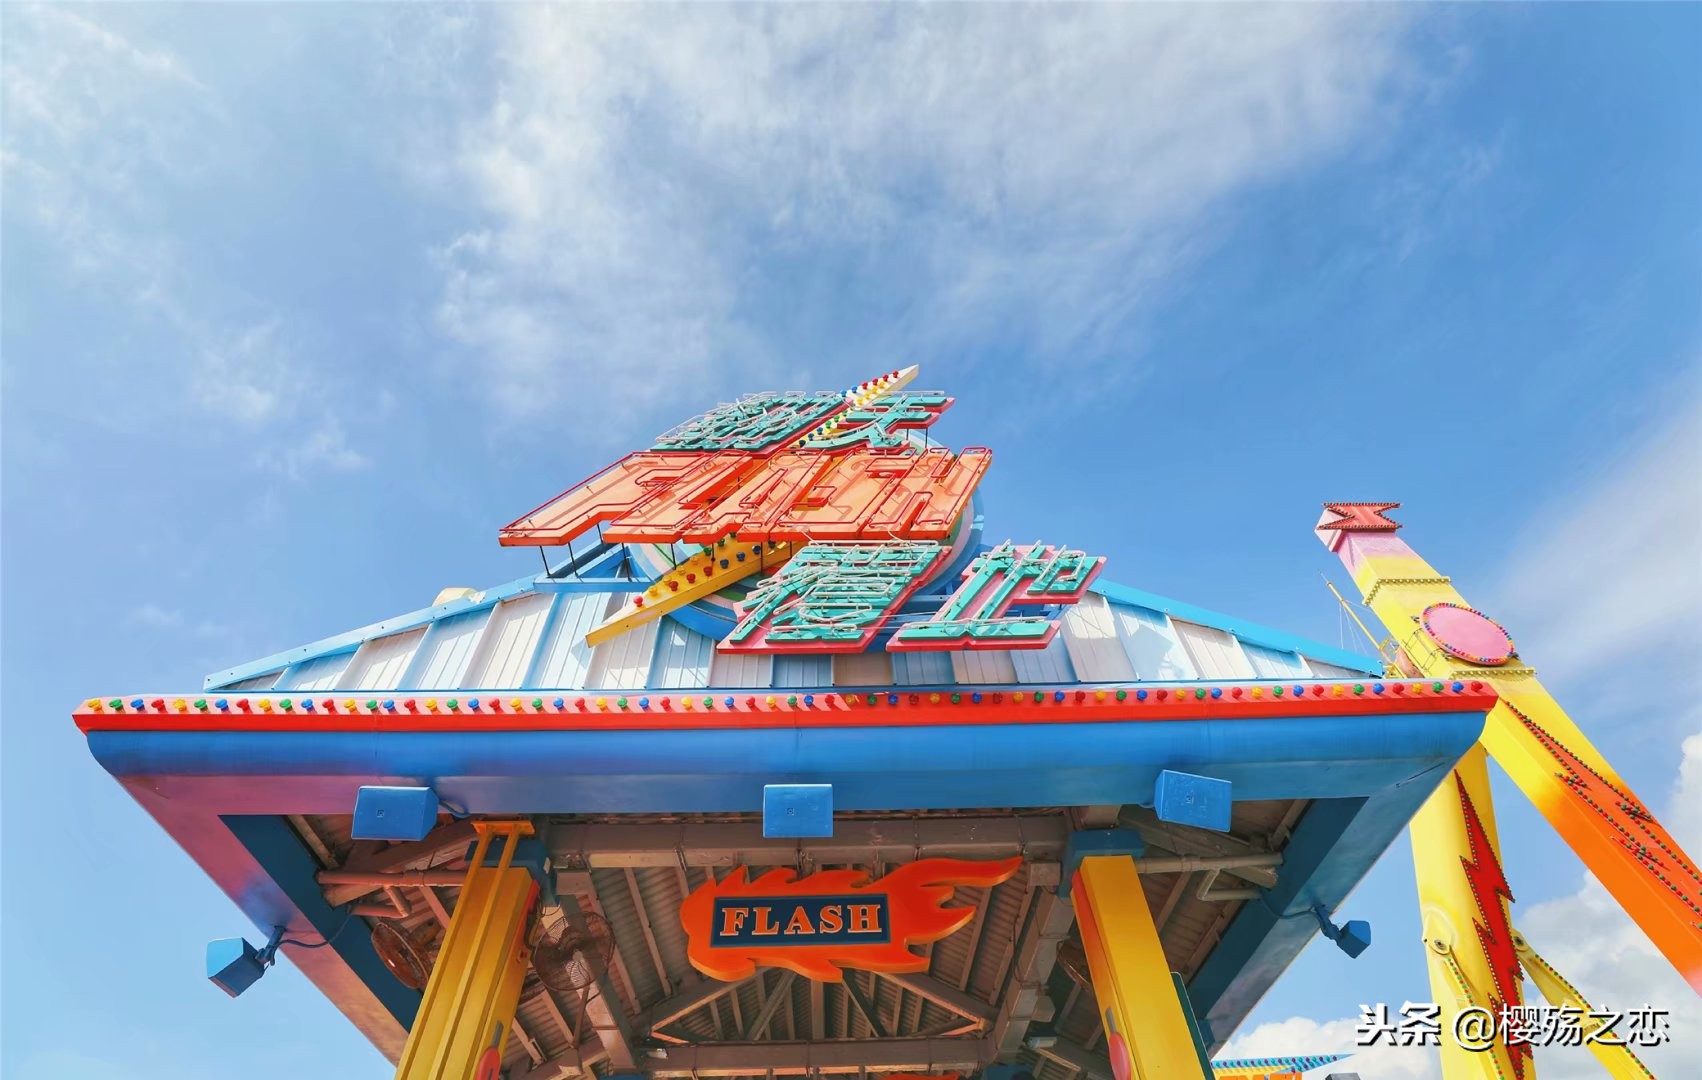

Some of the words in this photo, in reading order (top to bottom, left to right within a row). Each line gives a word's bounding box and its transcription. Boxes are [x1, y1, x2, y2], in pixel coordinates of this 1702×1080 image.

[500, 446, 993, 546] FLASH
[717, 540, 1107, 653] 覆地
[719, 904, 882, 936] FLASH
